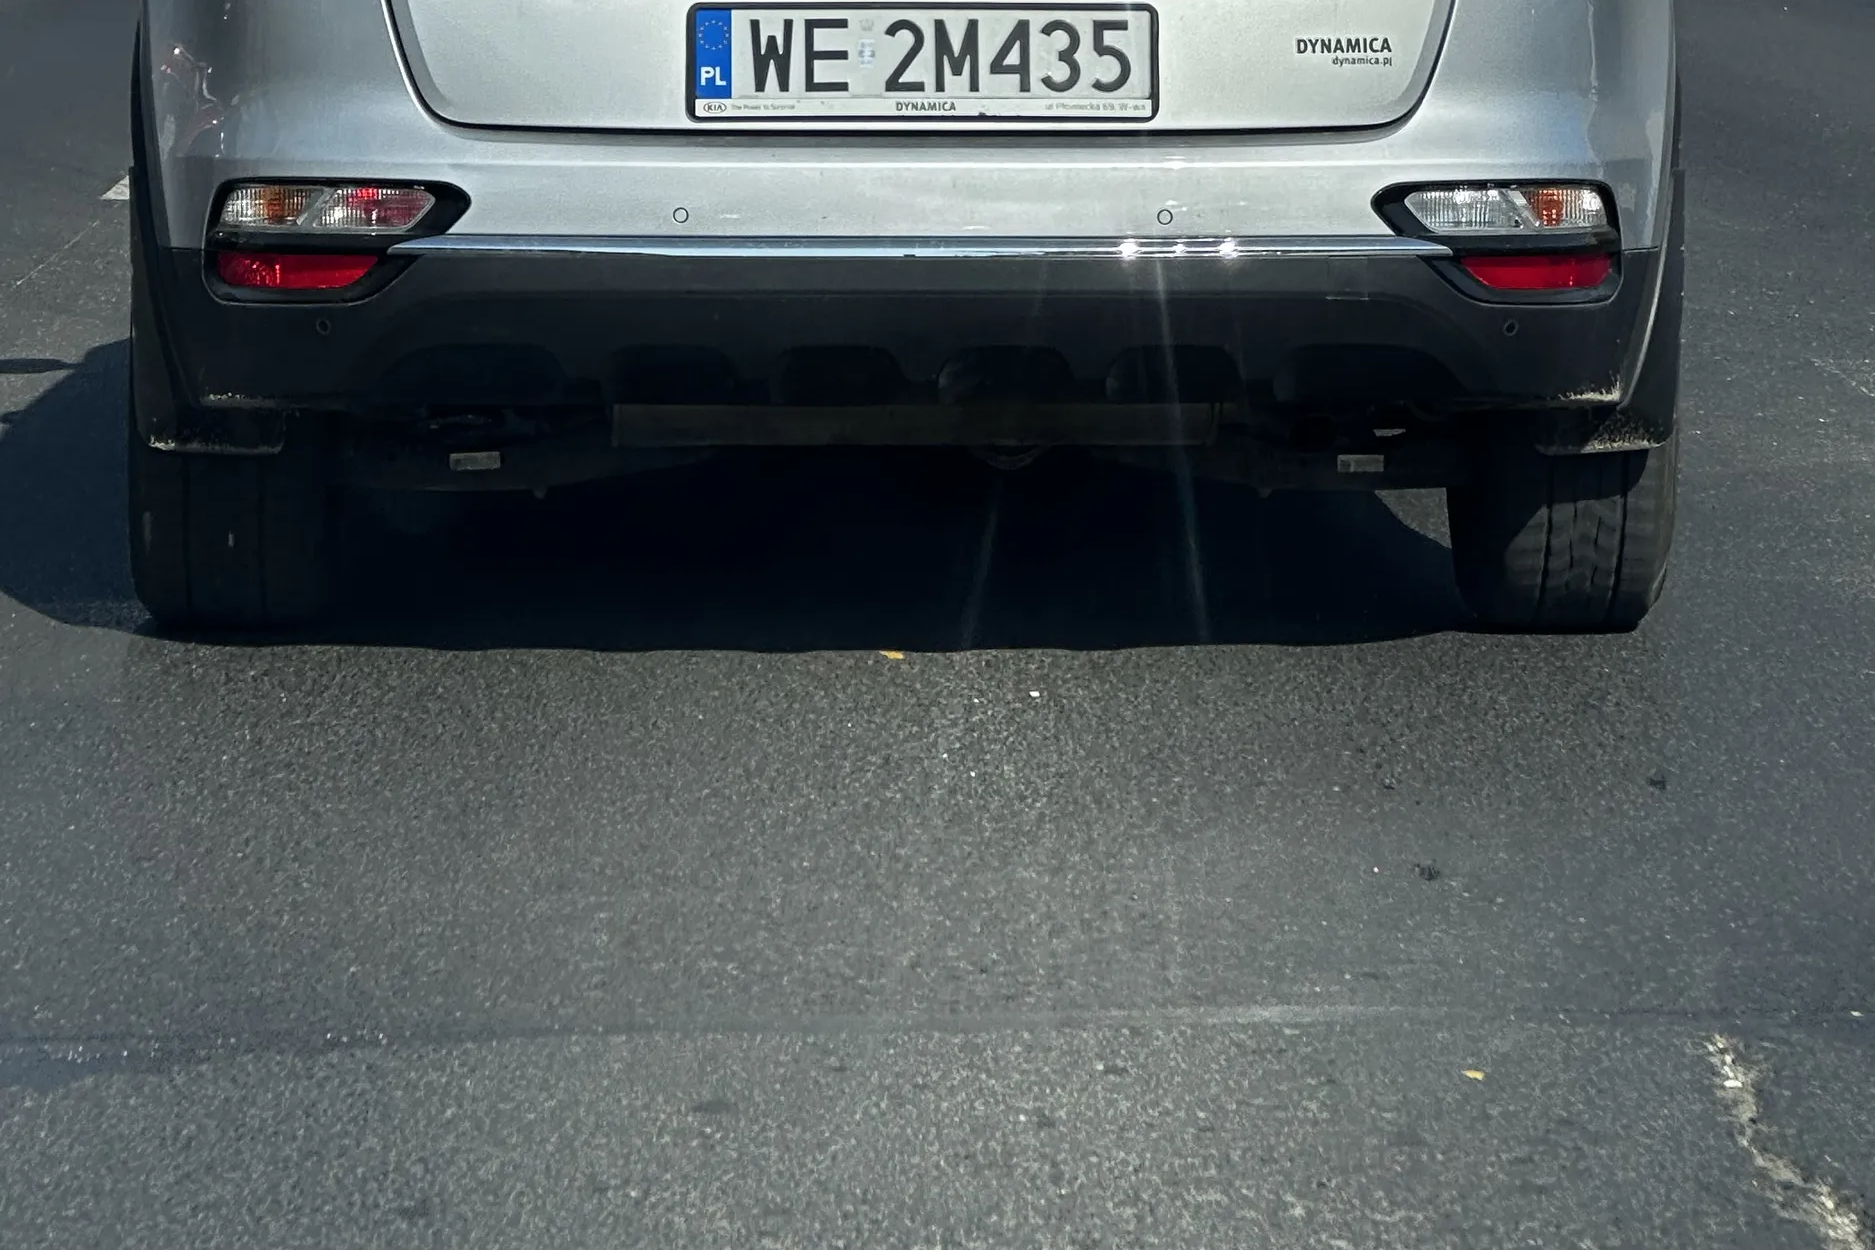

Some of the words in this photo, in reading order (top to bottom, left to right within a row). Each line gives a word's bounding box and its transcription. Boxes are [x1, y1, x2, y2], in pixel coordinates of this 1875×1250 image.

[1296, 37, 1392, 54] DYNAMICA
[749, 18, 849, 93] WE
[884, 18, 1132, 94] 2M435
[1332, 55, 1393, 67] dynamica.pl
[700, 66, 727, 86] PL
[895, 101, 957, 112] DYNAMICA
